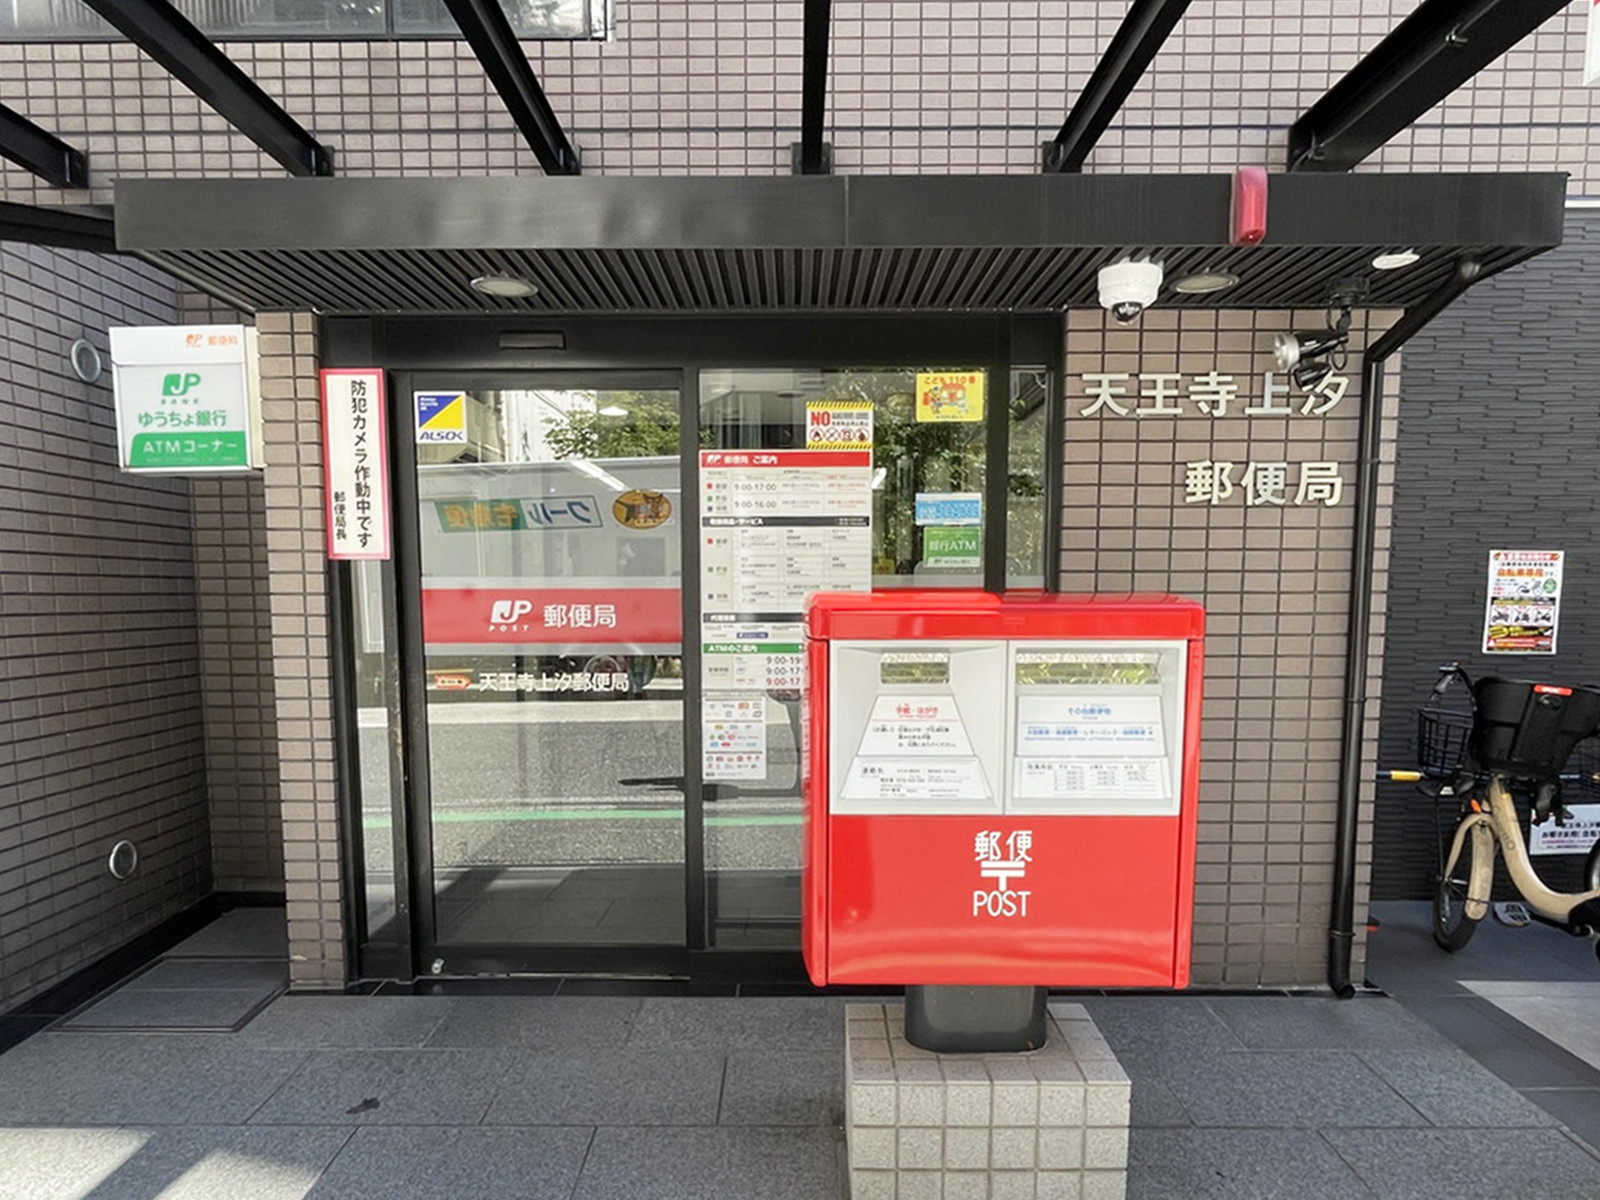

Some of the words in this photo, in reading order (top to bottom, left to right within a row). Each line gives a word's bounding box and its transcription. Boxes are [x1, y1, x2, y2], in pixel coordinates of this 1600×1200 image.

[208, 335, 238, 345] 郵便局
[162, 373, 201, 396] JP
[1080, 371, 1350, 416] 天王寺上汐
[138, 410, 227, 427] ゆうちょ銀行
[811, 411, 830, 426] NO
[143, 439, 237, 453] ATMコーナー
[420, 431, 463, 440] ALSOK
[351, 380, 372, 547] 防犯カメラ作動中です
[1184, 460, 1344, 507] 郵便局
[333, 491, 348, 540] 郵便局長
[490, 600, 532, 624] JP
[543, 604, 616, 628] 郵便局
[479, 672, 629, 692] 天王寺上汐郵便局
[974, 830, 1032, 861] 郵便
[973, 890, 1031, 917] POST
